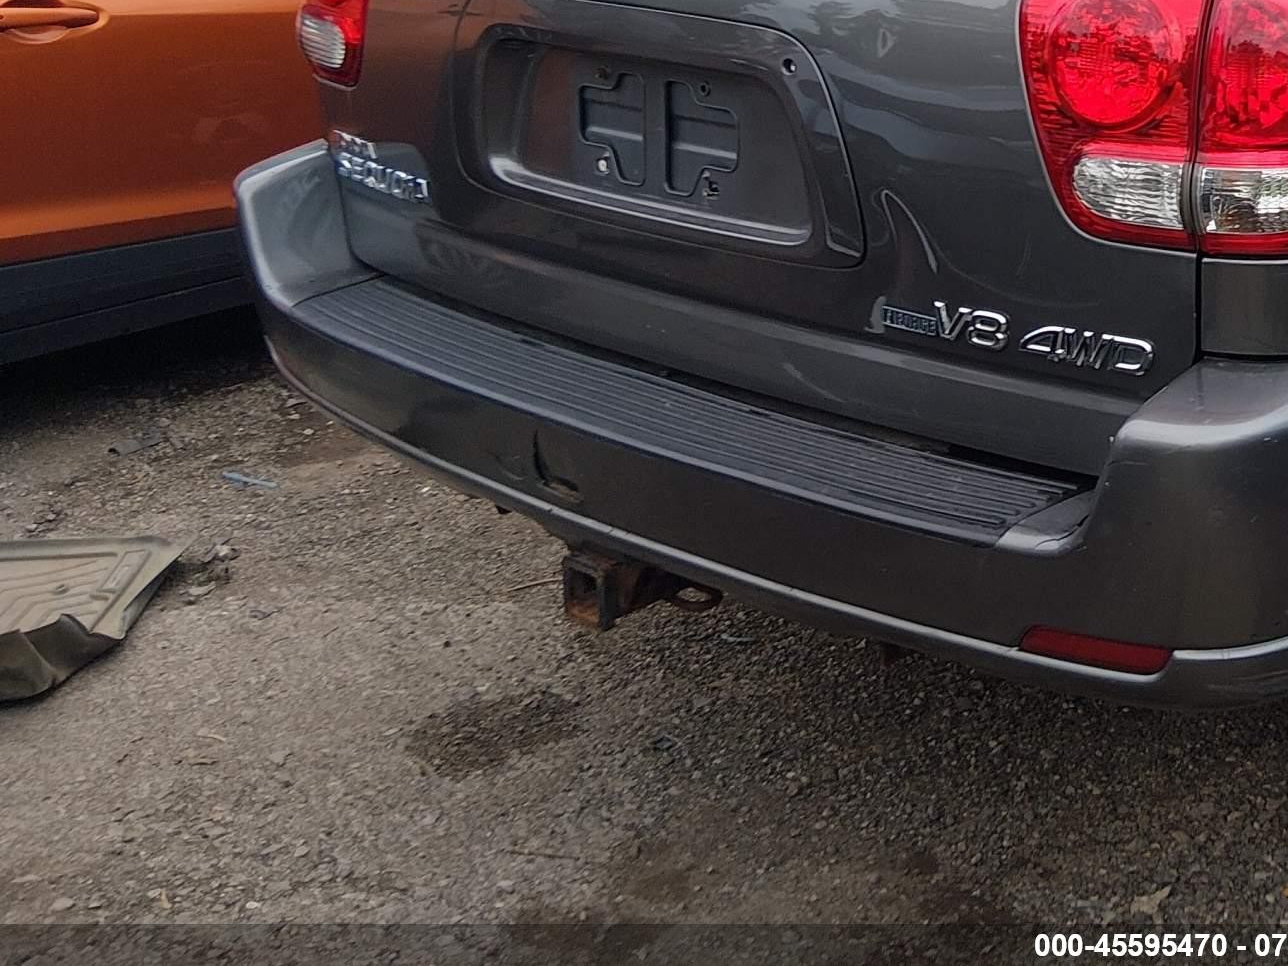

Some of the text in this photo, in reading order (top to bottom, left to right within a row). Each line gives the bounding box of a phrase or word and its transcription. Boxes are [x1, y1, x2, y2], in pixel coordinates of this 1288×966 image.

[338, 151, 431, 203] SEQUOIA
[931, 300, 1011, 352] V8
[1018, 325, 1157, 376] 4WD
